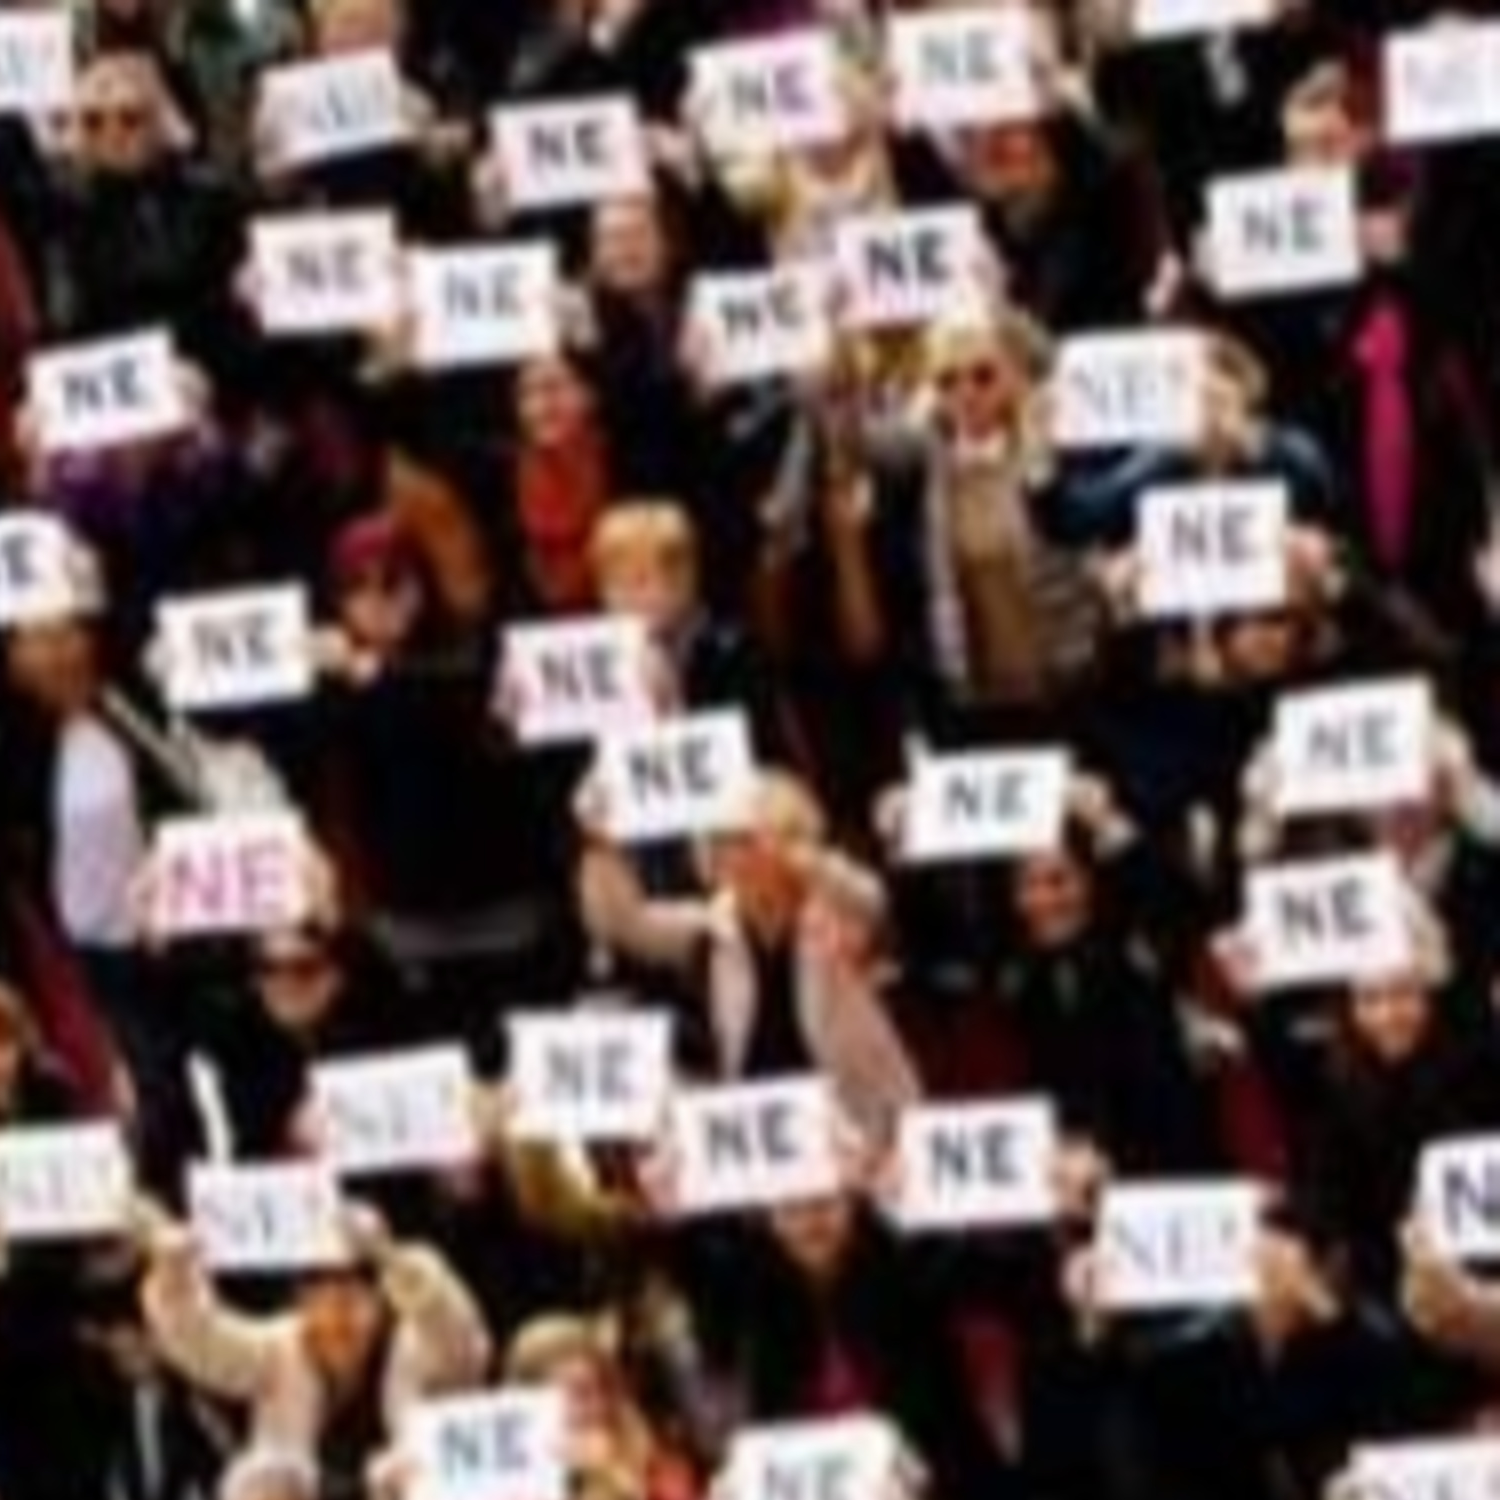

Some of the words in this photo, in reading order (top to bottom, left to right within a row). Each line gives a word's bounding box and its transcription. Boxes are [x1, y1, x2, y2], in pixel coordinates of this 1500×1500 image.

[918, 32, 1000, 82] NE
[728, 62, 812, 114] NE
[525, 120, 608, 168] NE
[1240, 200, 1328, 254] NE
[285, 240, 368, 296] NE
[862, 230, 950, 288] NE
[442, 262, 522, 318] NE
[715, 283, 802, 336] NE
[62, 355, 142, 416] NE
[1168, 505, 1260, 566] NE
[192, 615, 280, 670] NE
[535, 650, 622, 704] NE
[1305, 712, 1400, 768] NE
[625, 735, 712, 804] NE
[940, 768, 1028, 824] NE
[171, 842, 290, 908] NE
[1277, 880, 1376, 946] NE
[546, 1044, 628, 1104] NE
[702, 1103, 799, 1164] NE
[929, 1123, 1017, 1186] NE
[1442, 1164, 1500, 1230] N
[440, 1411, 529, 1478] NE
